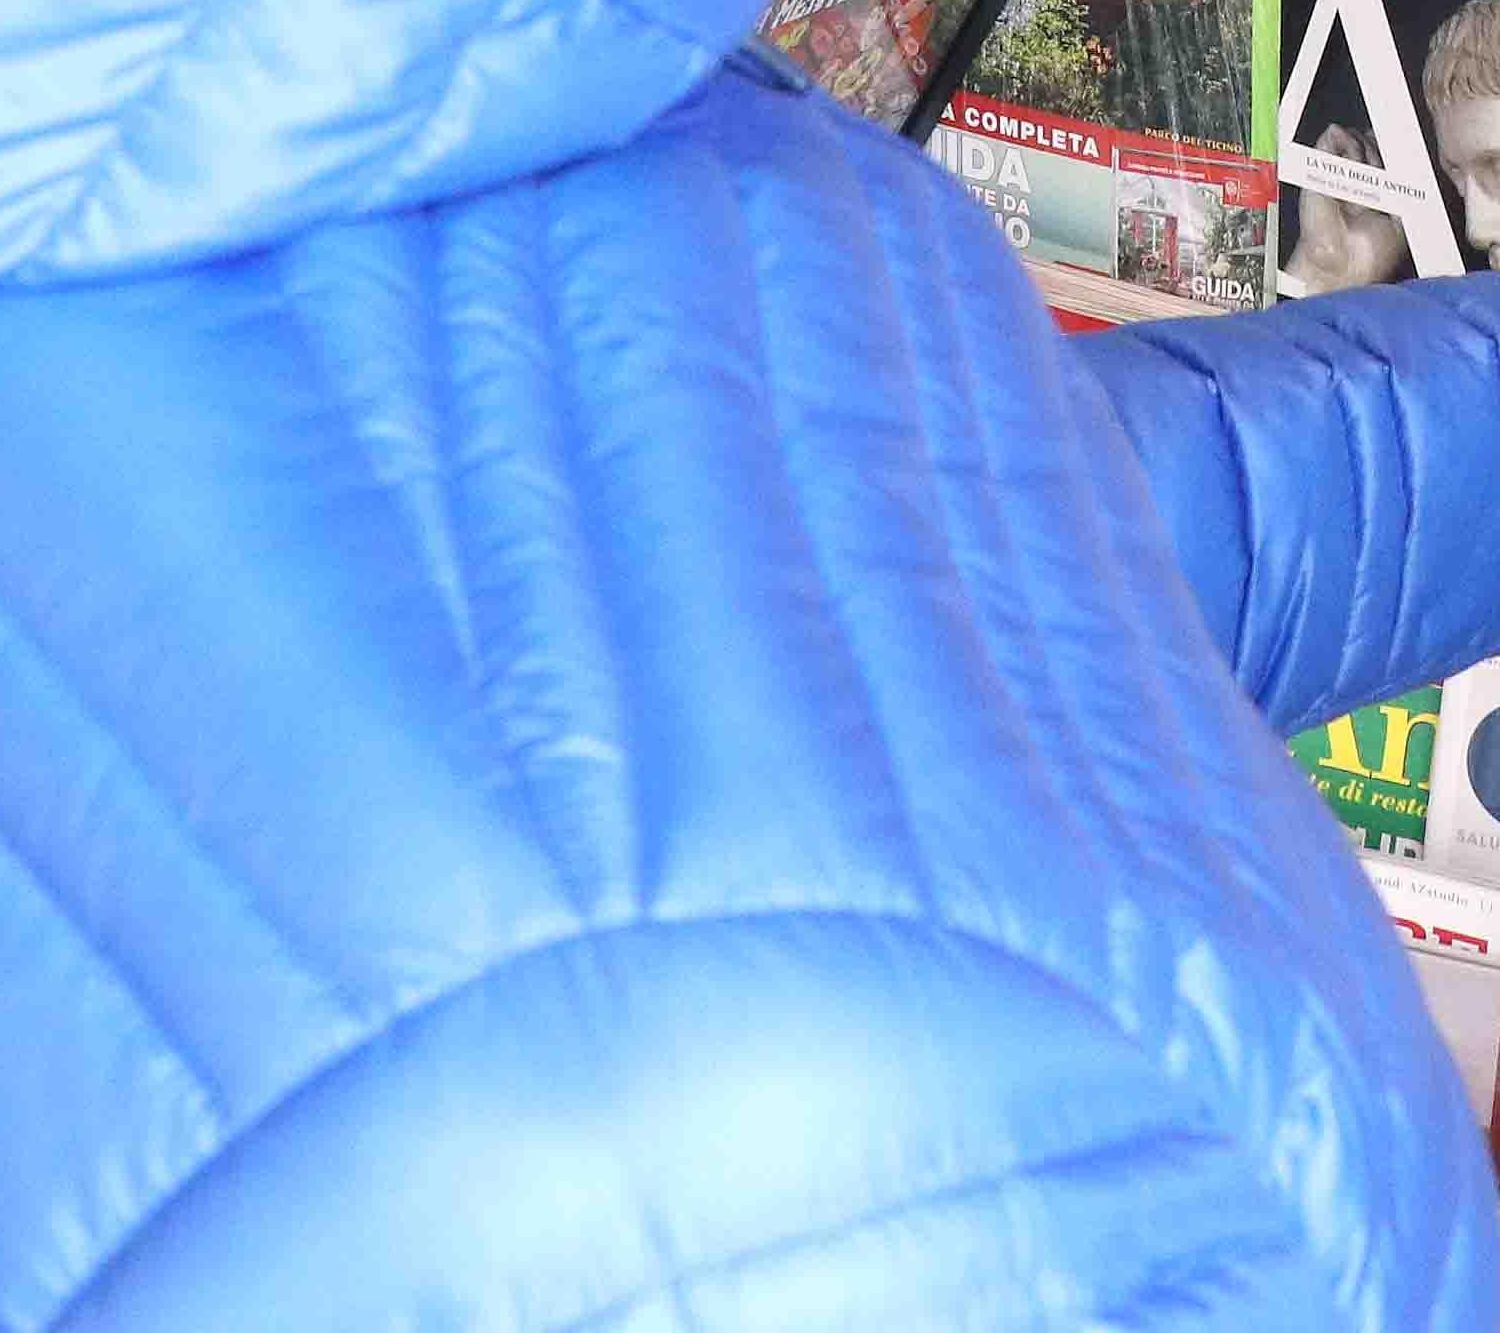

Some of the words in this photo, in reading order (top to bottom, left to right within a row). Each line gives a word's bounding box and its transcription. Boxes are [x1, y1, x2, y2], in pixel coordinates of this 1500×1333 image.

[964, 106, 1100, 159] COMPLETA
[1322, 160, 1348, 178] VITA
[1382, 179, 1427, 202] ANTICHI
